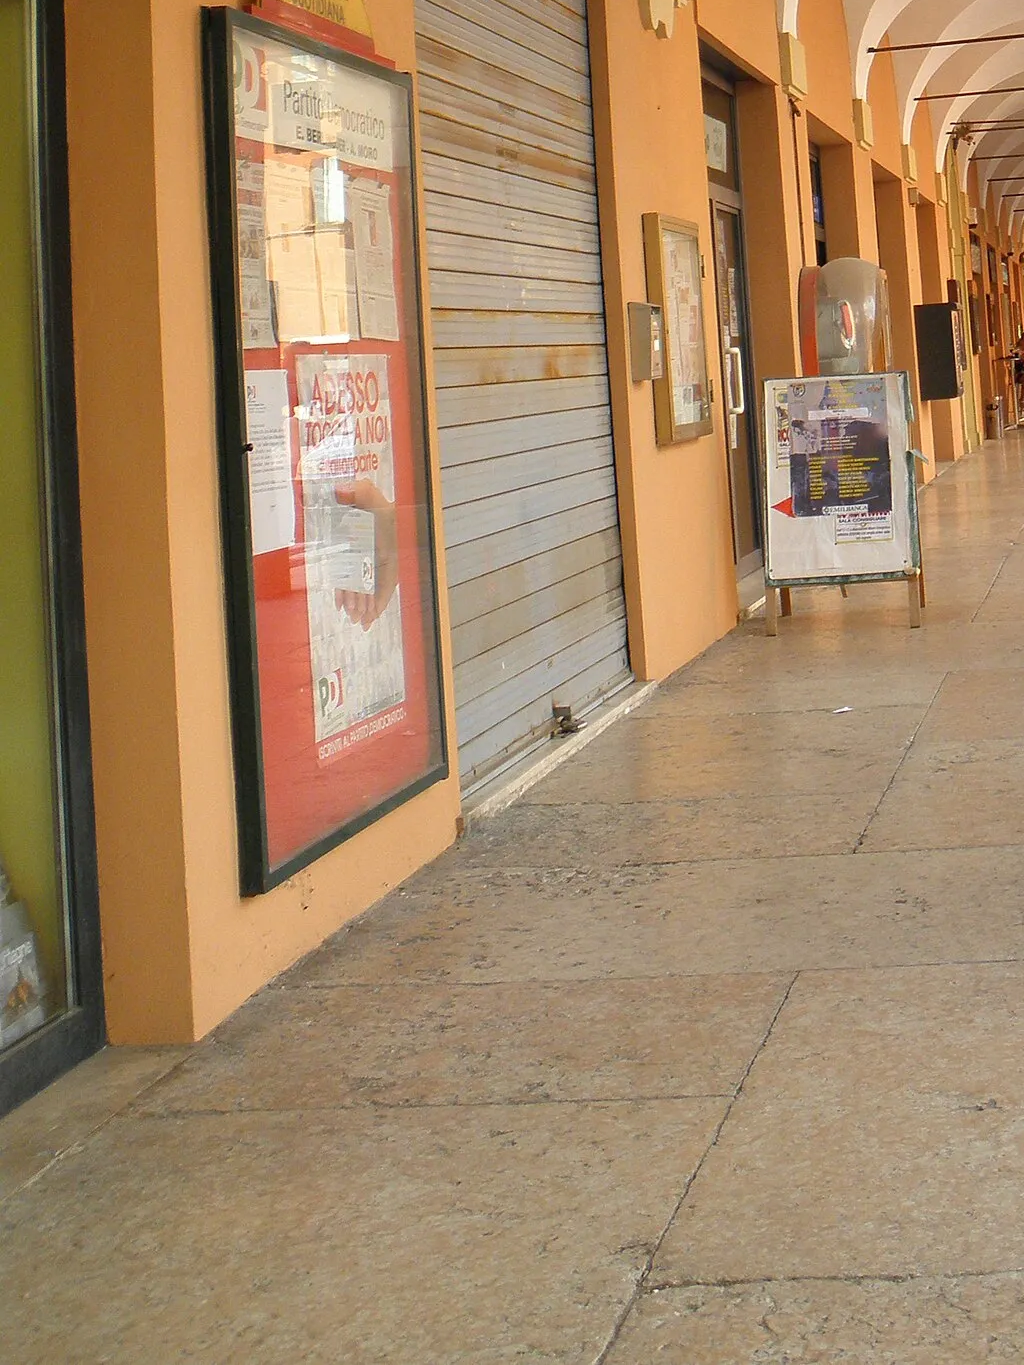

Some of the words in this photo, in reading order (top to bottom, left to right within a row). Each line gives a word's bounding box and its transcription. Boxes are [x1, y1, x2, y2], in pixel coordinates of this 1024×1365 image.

[283, 80, 323, 120] Partito
[324, 87, 385, 141] Democratico
[295, 125, 305, 140] E.
[358, 143, 378, 160] MORO
[310, 372, 379, 417] ADESSO
[354, 417, 362, 446] A
[366, 416, 388, 445] NOI
